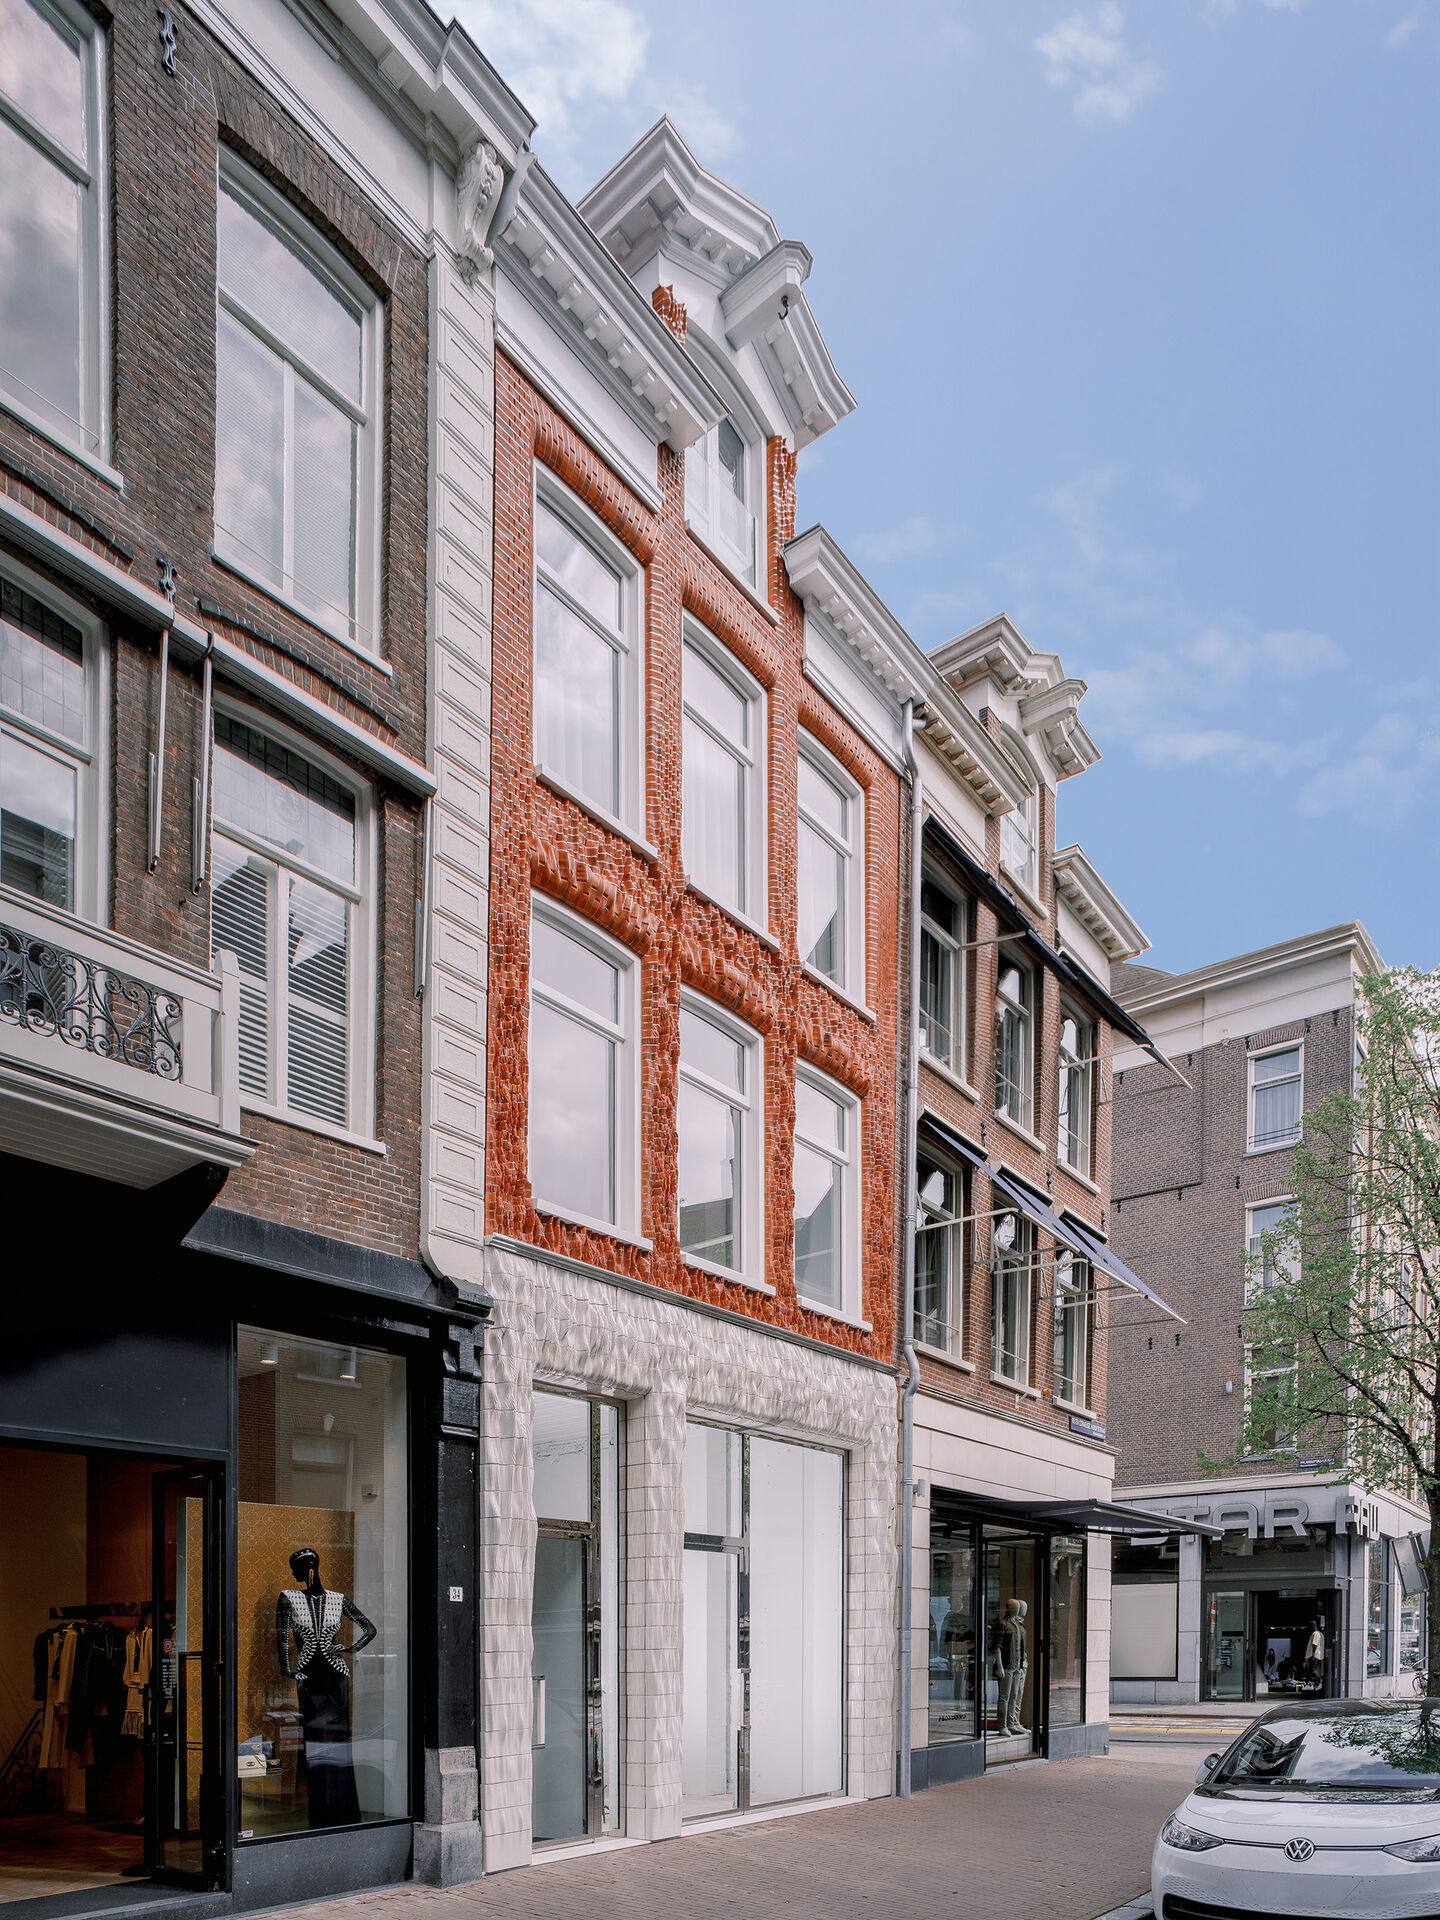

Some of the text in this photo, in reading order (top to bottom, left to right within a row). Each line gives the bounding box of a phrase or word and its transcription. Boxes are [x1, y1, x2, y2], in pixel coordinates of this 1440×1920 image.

[1335, 1496, 1380, 1541] RAW
[452, 1589, 461, 1600] 34
[1285, 1838, 1315, 1861] VW
